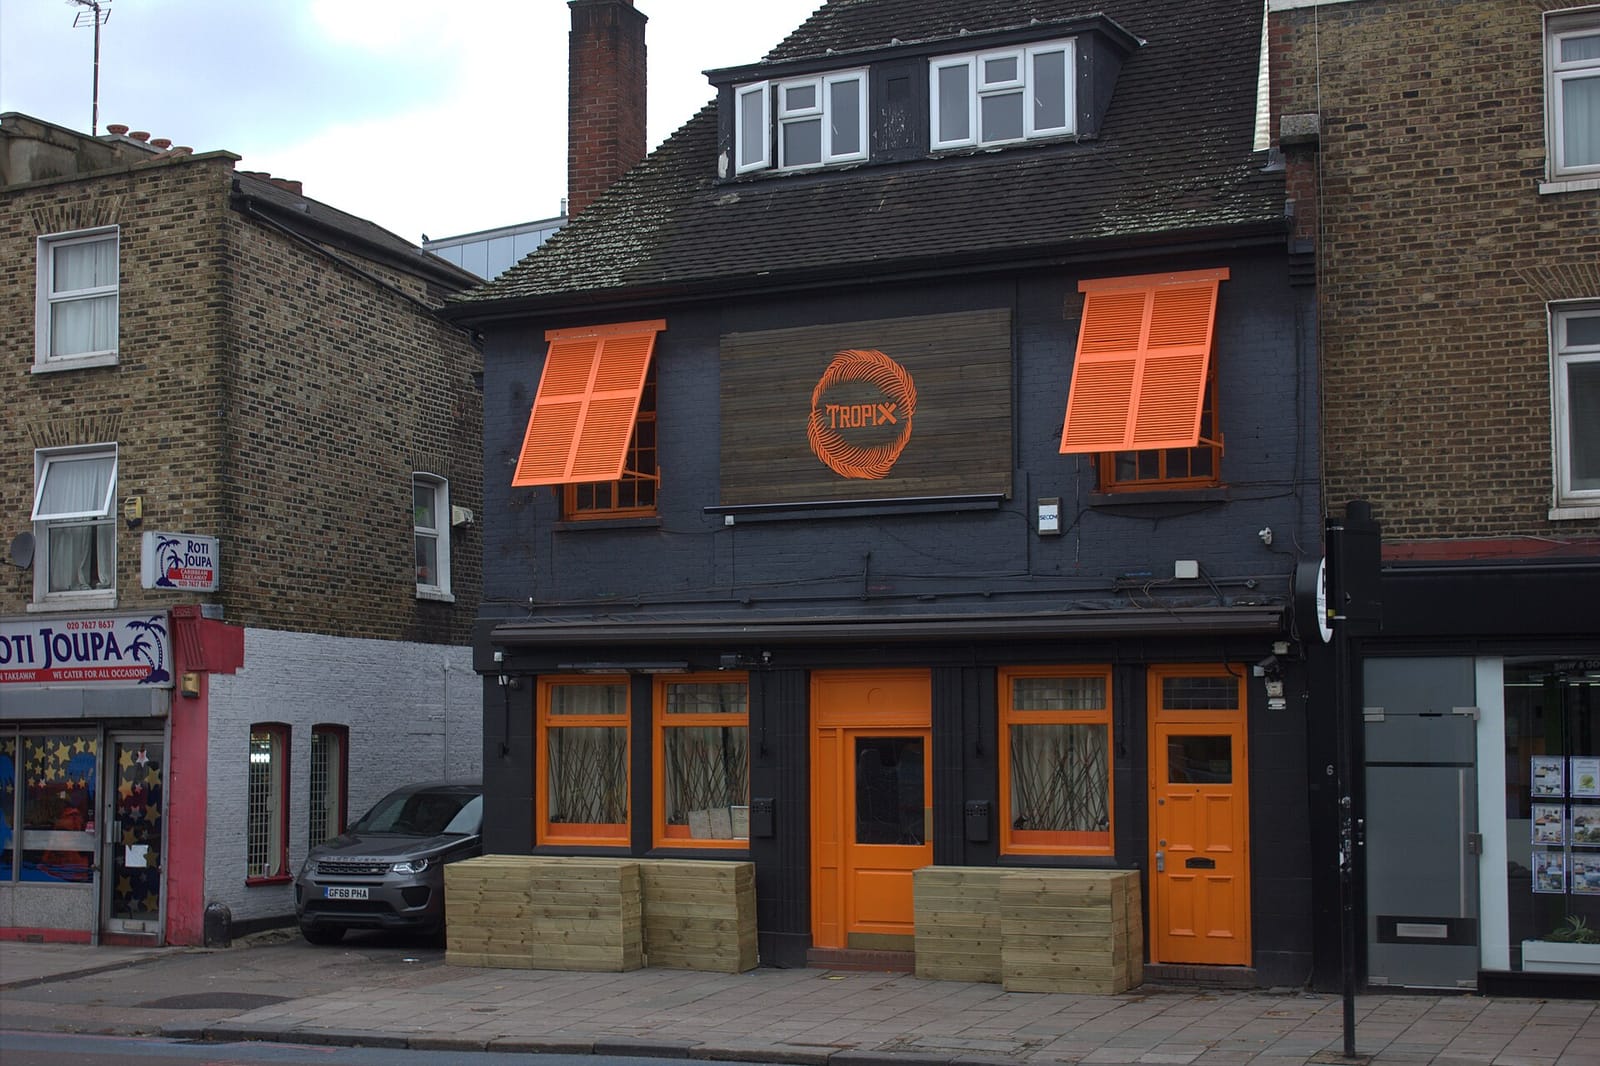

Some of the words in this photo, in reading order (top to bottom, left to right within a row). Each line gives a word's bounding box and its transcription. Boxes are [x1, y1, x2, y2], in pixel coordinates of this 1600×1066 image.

[825, 402, 897, 429] TROPIX
[188, 540, 208, 554] ROTI
[184, 553, 212, 568] JOUPA
[67, 621, 79, 629] 020
[81, 621, 96, 629] 7627
[99, 621, 115, 629] 8637
[40, 628, 123, 669] JOUPA
[4, 672, 36, 680] TAKEAWAY
[64, 671, 83, 679] CATER
[84, 670, 97, 678] FOR
[98, 670, 110, 678] ALL
[112, 669, 148, 678] OCCASIONS
[1326, 764, 1334, 776] 6
[352, 889, 367, 898] PHA
